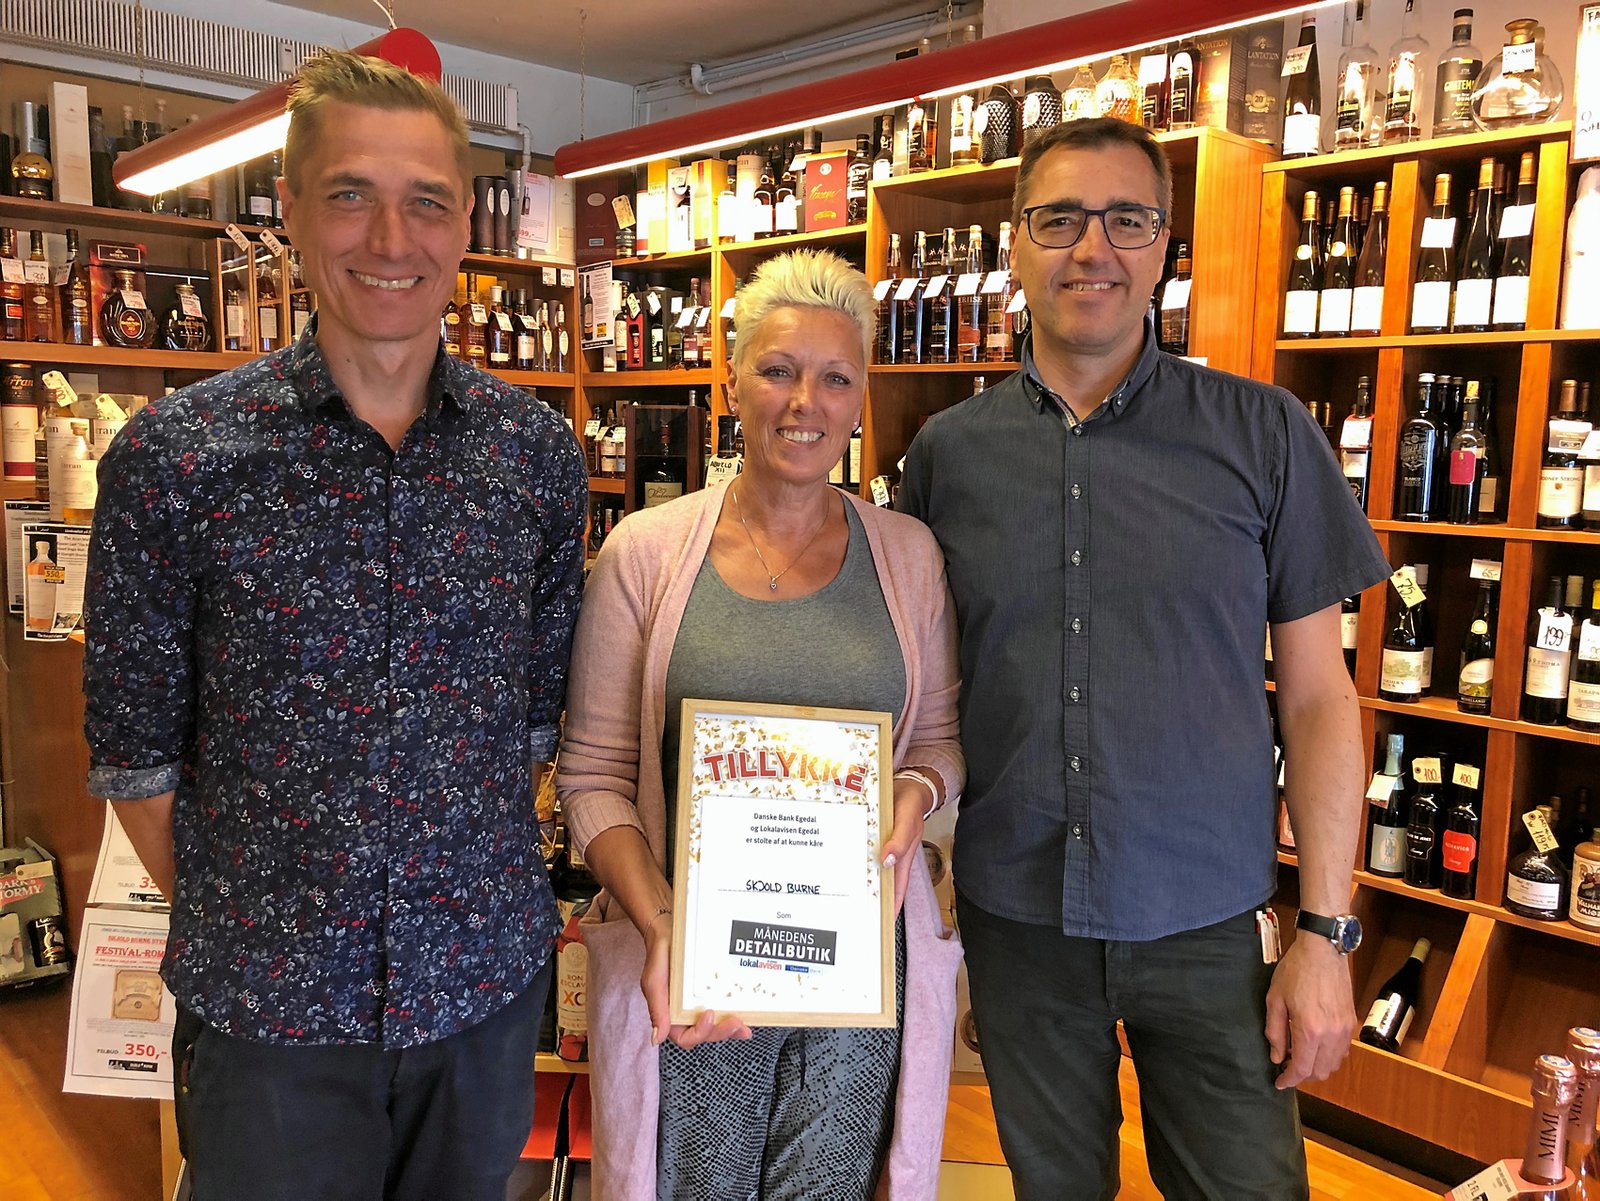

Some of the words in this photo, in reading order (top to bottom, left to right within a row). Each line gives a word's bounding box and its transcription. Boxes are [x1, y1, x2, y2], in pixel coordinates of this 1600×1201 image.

[703, 750, 867, 793] TILLYKKE
[753, 812, 777, 821] Danske
[778, 814, 795, 822] Bank
[795, 815, 817, 824] Egedal
[750, 825, 759, 834] og
[760, 824, 797, 834] Lokalavisen
[798, 826, 820, 836] Egedal
[754, 837, 772, 845] stolte
[788, 838, 809, 846] kunne
[809, 839, 823, 847] kåre
[746, 880, 782, 893] SKJOLD
[787, 883, 820, 895] BURNE
[776, 911, 792, 919] Som
[754, 926, 815, 945] MÅNEDENS
[735, 939, 830, 962] DETAILBUTIK
[740, 958, 782, 971] lokalavisen
[567, 974, 583, 982] RON
[125, 1043, 167, 1059] 350,-
[1538, 1112, 1560, 1162] MIMI
